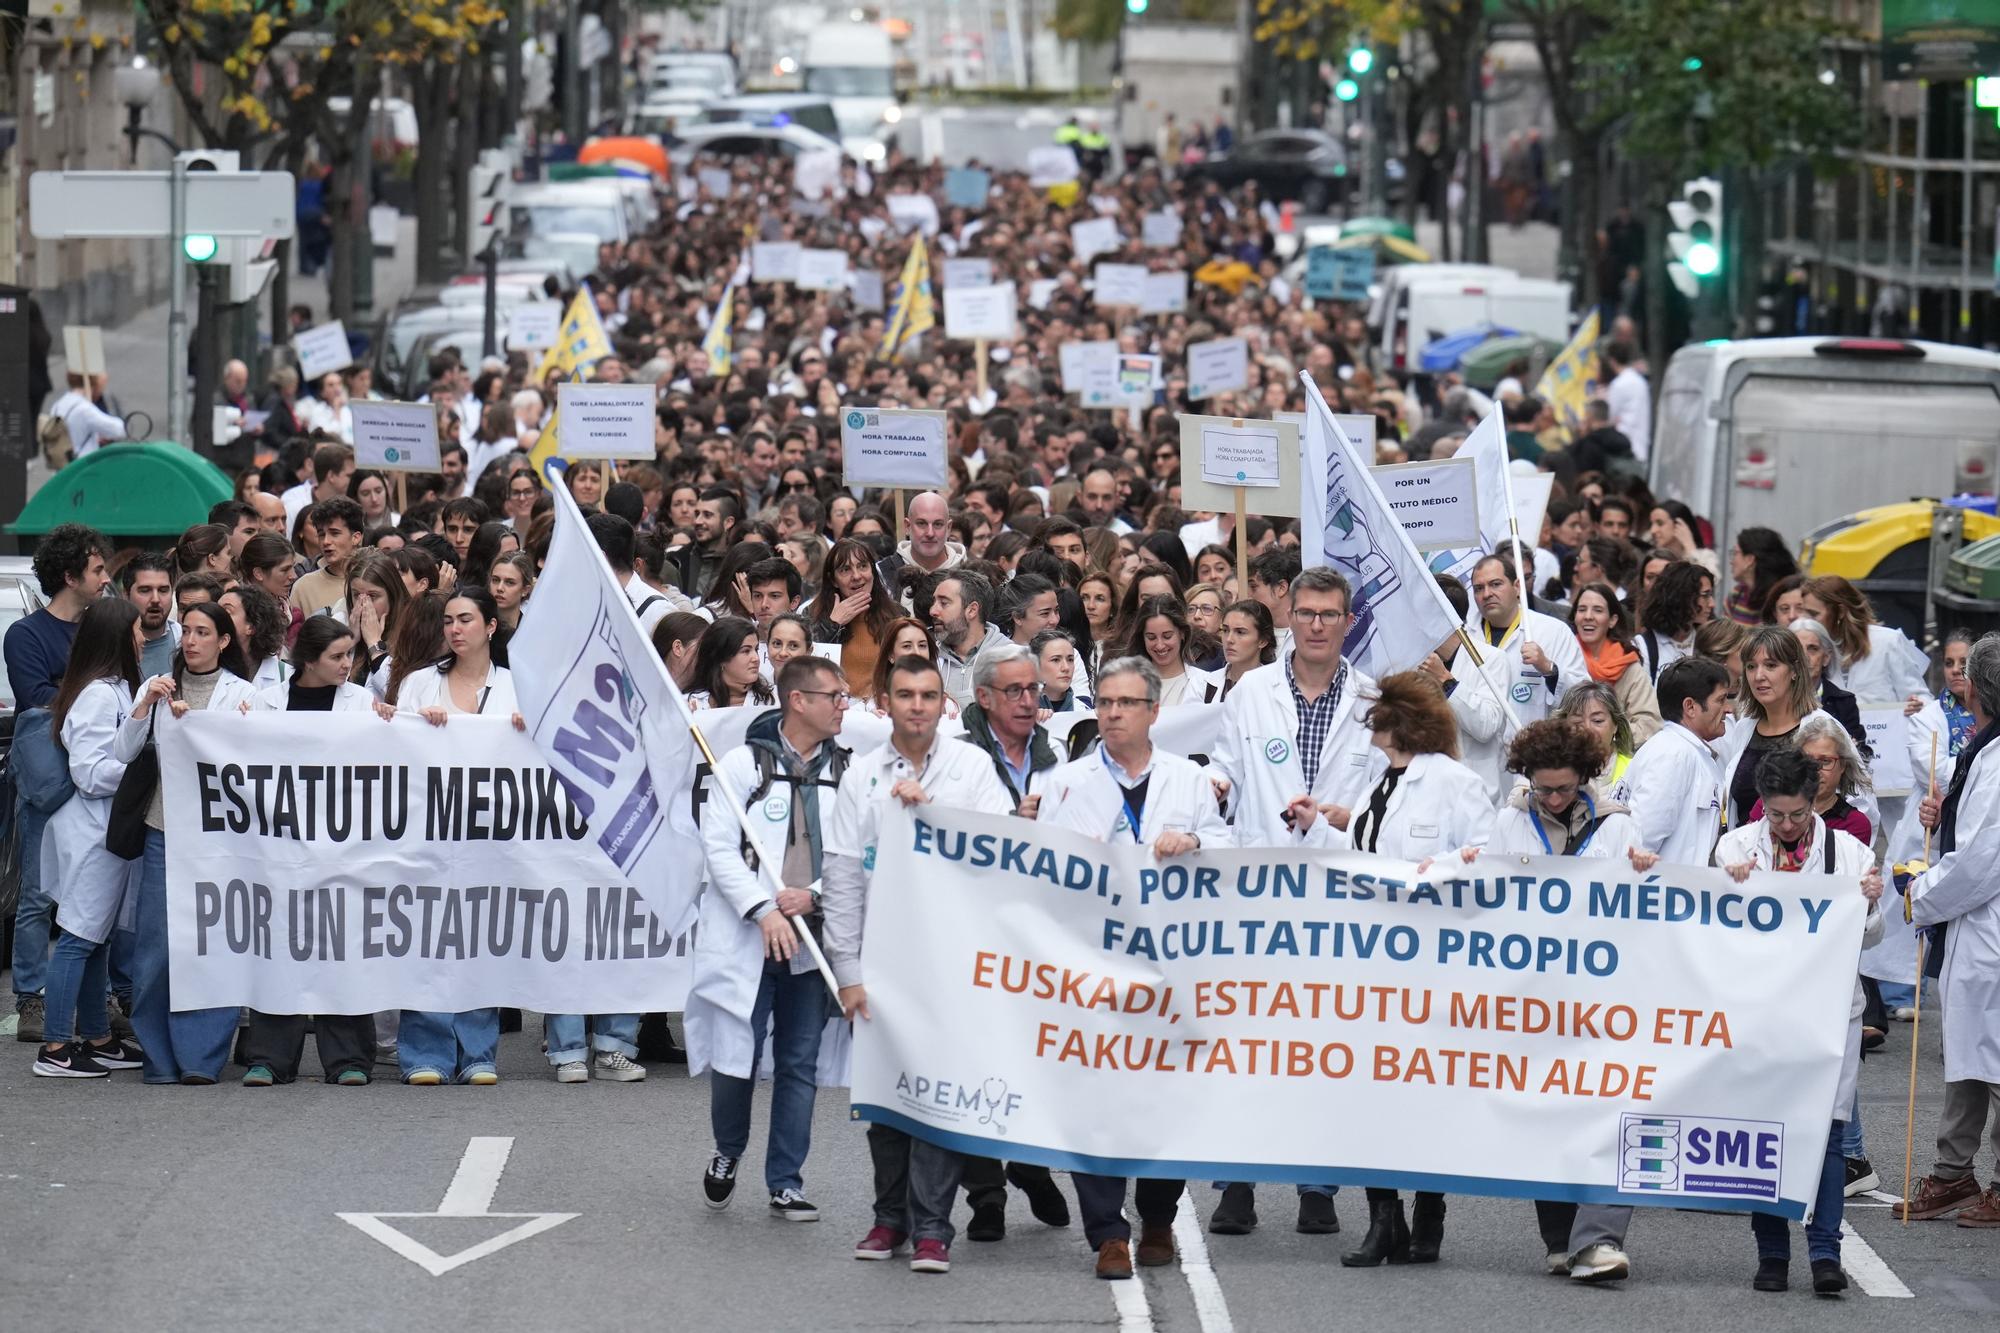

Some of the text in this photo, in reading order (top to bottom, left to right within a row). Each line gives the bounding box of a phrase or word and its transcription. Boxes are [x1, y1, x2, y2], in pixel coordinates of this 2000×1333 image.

[883, 449, 927, 457] COMPUTADA
[884, 434, 926, 442] TRABAJADA
[1217, 446, 1264, 456] HORA TRABAJADA
[1230, 455, 1266, 463] COMPUTADA
[1389, 500, 1419, 509] ATUTO
[1395, 477, 1430, 487] POR UN
[196, 761, 409, 843] ESTATUTU
[913, 817, 1833, 934] EUSKADI, POR UN ESTATUTO MÉDICO Y
[195, 878, 272, 961] POR
[288, 887, 346, 962] UN
[362, 884, 570, 963] ESTATUTO
[1102, 917, 1620, 977] FACULTATIVO PROPIO
[972, 951, 1734, 1049] EUSKADI, ESTATUTU MEDIKO ETA
[1035, 1022, 1658, 1101] FAKULTATIBO BATEN ALDE
[1684, 1126, 1780, 1171] SME
